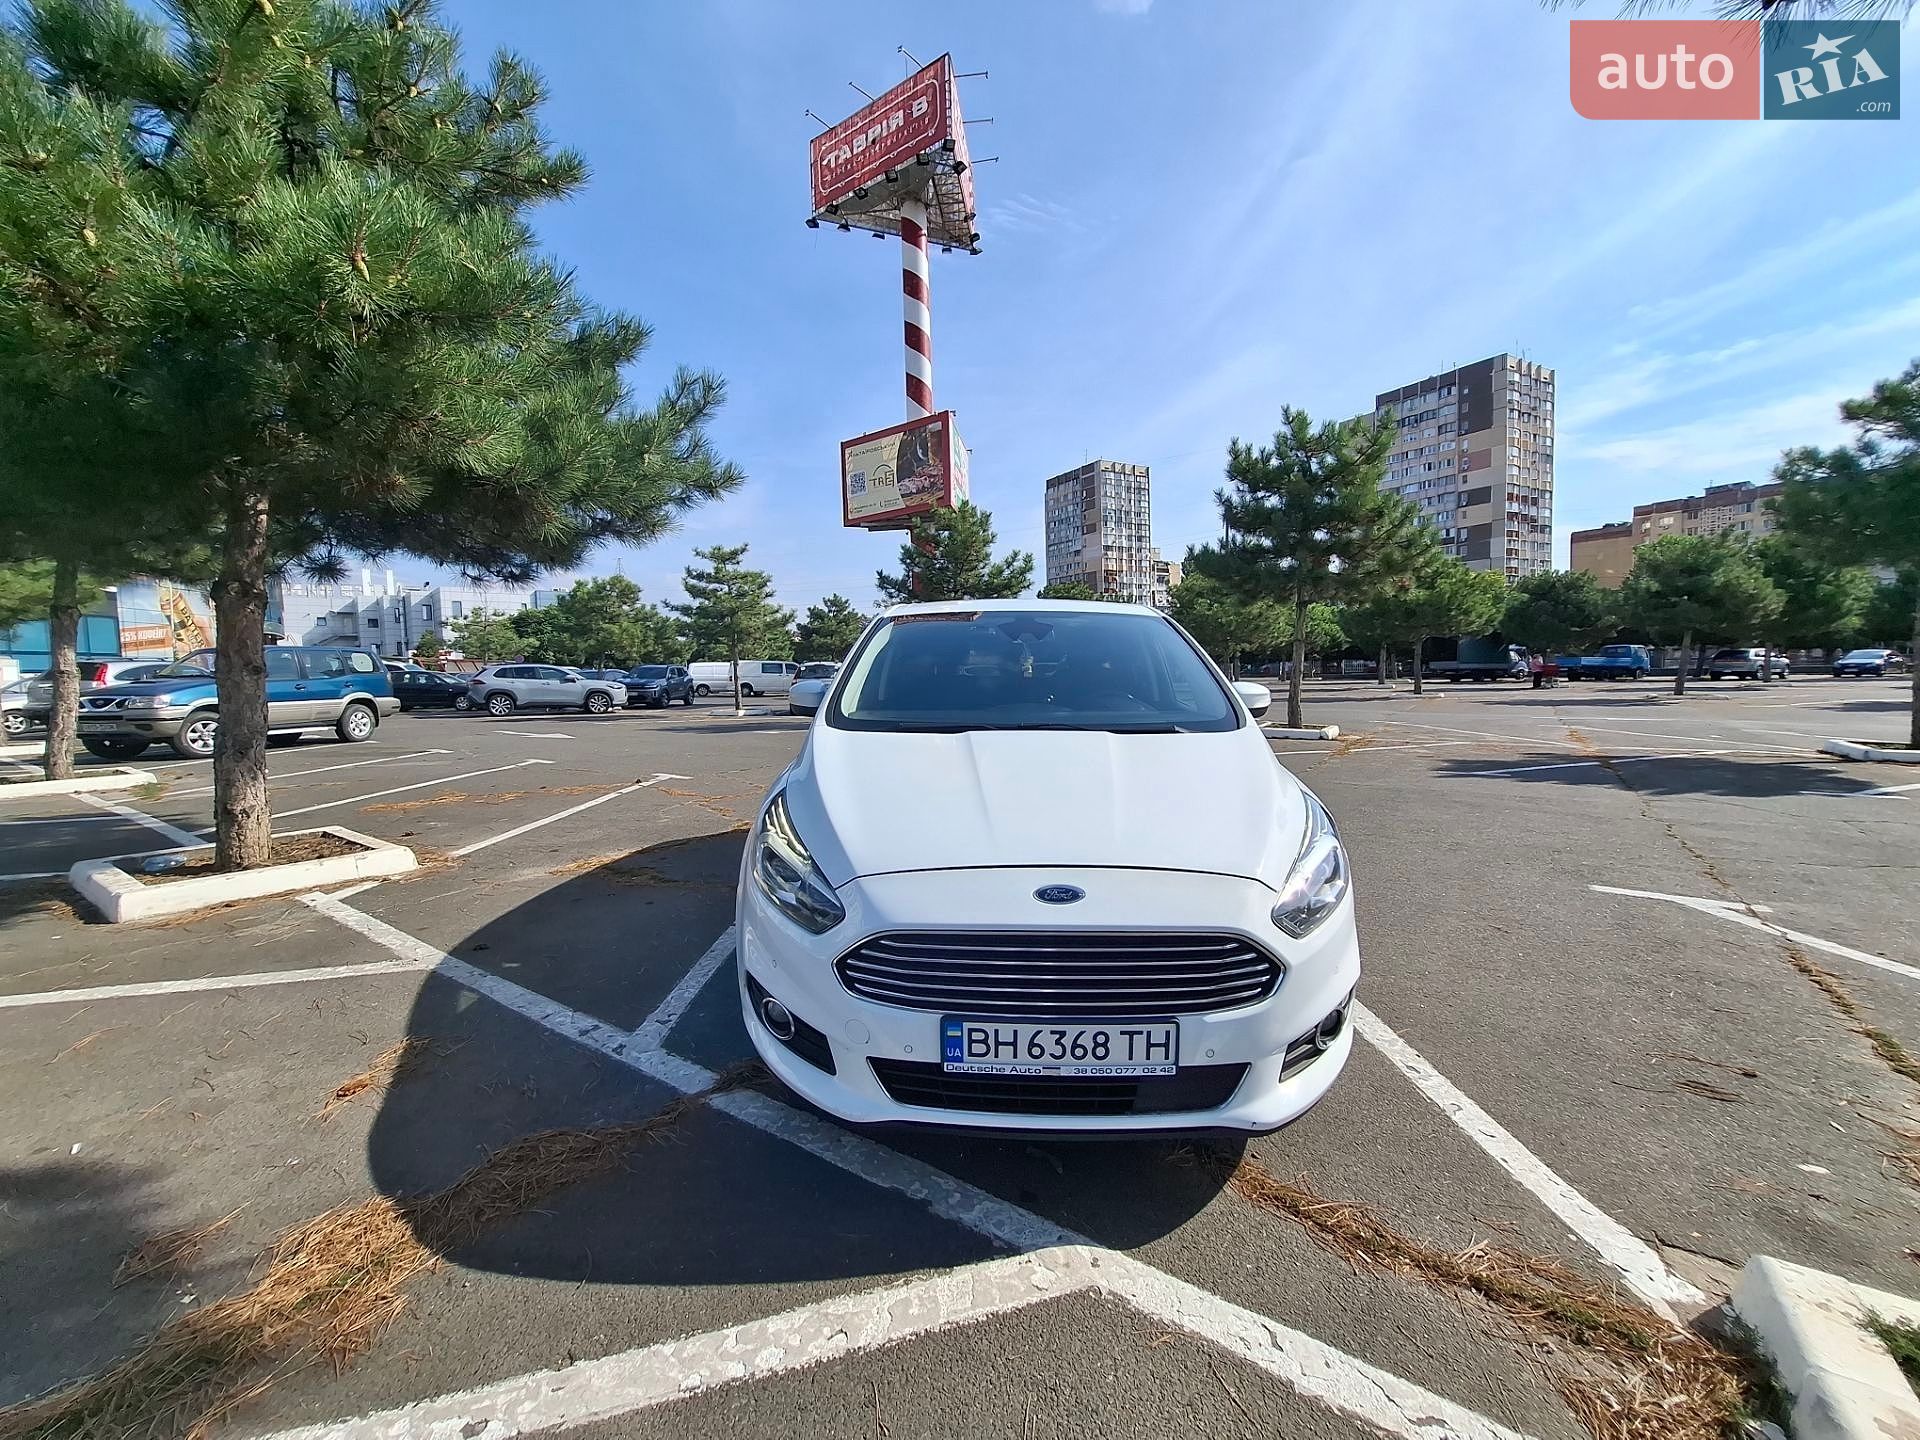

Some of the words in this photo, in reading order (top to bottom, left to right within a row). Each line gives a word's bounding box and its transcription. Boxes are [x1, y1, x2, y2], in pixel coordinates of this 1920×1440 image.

[821, 109, 904, 168] ТАВРІЯ
[1044, 888, 1073, 900] Ford
[967, 1028, 1018, 1059] BH
[1027, 1030, 1110, 1061] 6368
[1120, 1030, 1170, 1061] TH
[947, 1047, 962, 1057] UA
[946, 1063, 1006, 1073] Deutsche
[1009, 1065, 1041, 1074] Auto
[1142, 1066, 1157, 1074] 02
